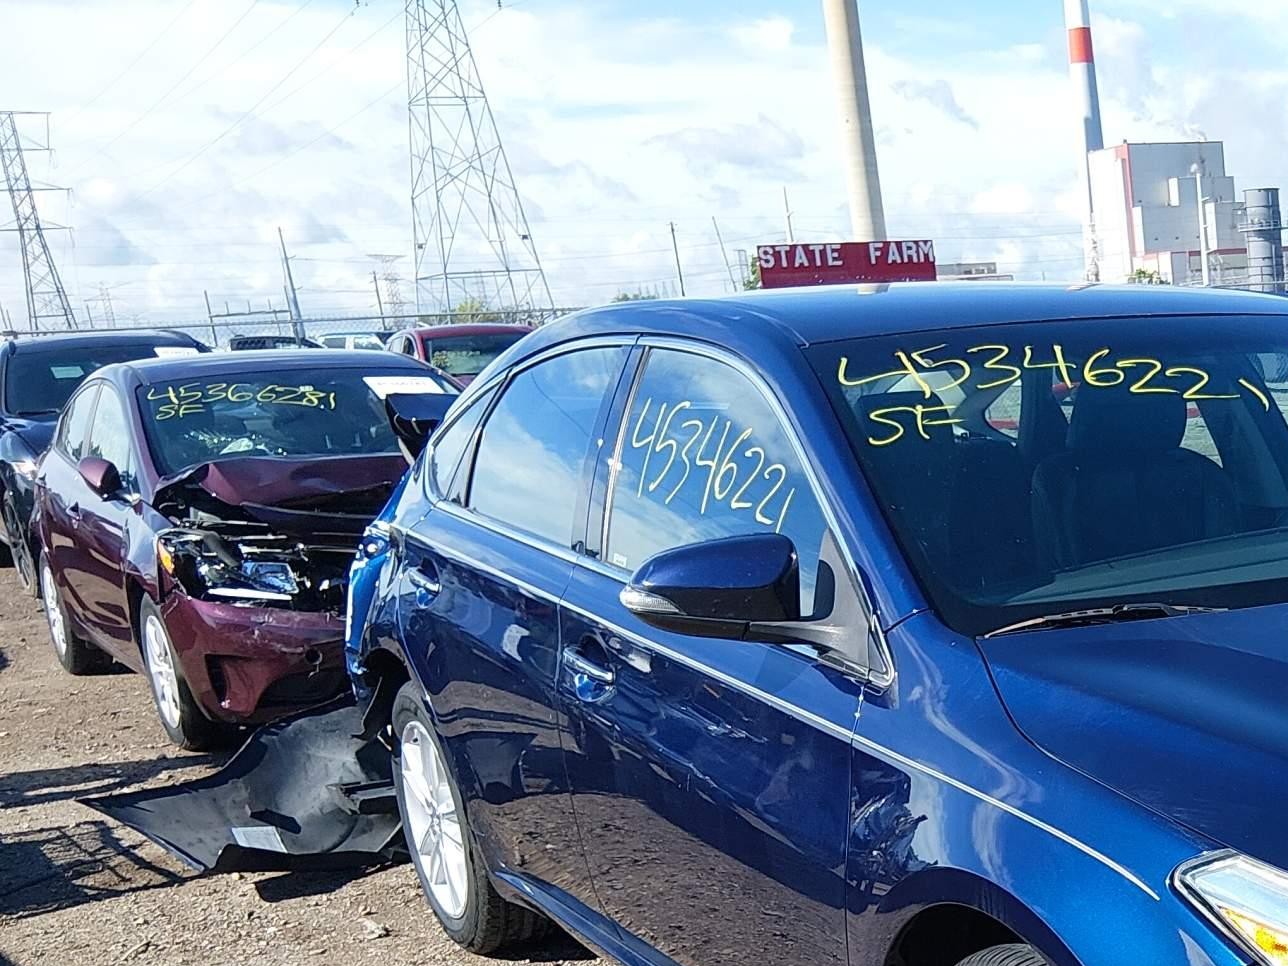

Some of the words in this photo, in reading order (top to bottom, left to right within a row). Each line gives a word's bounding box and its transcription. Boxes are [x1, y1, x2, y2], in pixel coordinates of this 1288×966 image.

[758, 243, 844, 269] STATE
[868, 241, 936, 265] FARM
[837, 343, 1270, 412] 45346221
[155, 404, 206, 421] SF
[868, 404, 966, 446] SF
[631, 397, 796, 534] 45346221
